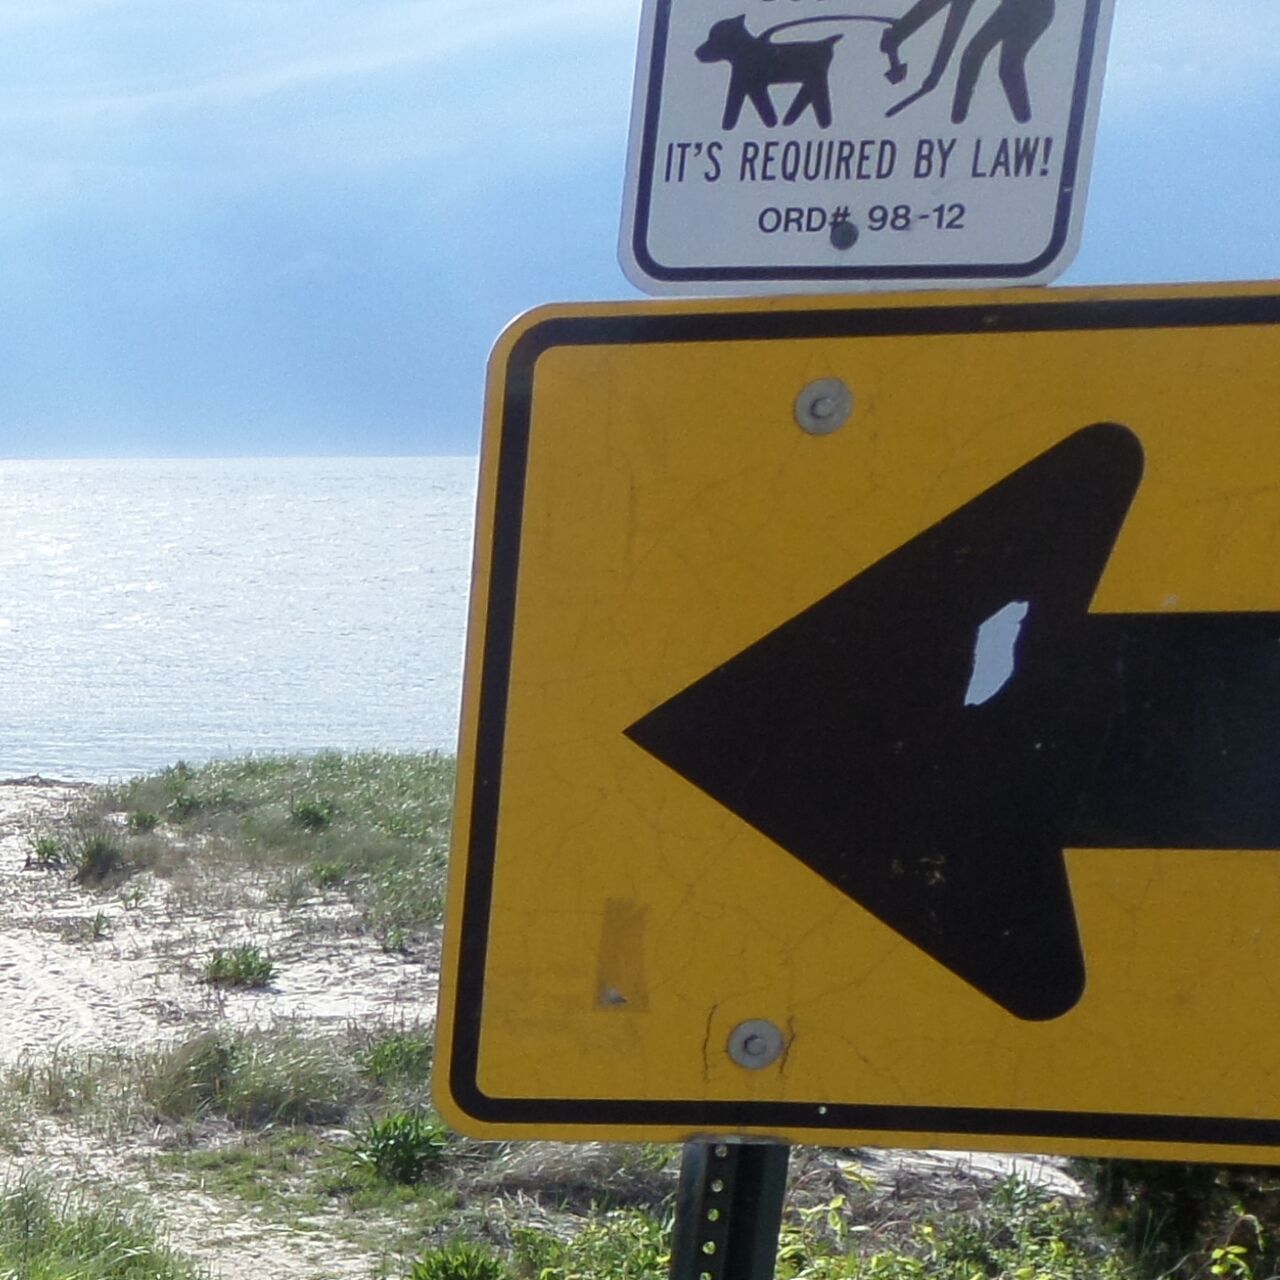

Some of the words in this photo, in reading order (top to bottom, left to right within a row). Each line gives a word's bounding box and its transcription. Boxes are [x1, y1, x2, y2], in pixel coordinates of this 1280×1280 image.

[664, 141, 723, 183] IT'S
[739, 139, 897, 183] REQUIRED
[912, 138, 957, 180] BY
[970, 136, 1054, 179] LAW!
[757, 204, 851, 234] ORD#
[866, 203, 967, 233] 98-12
